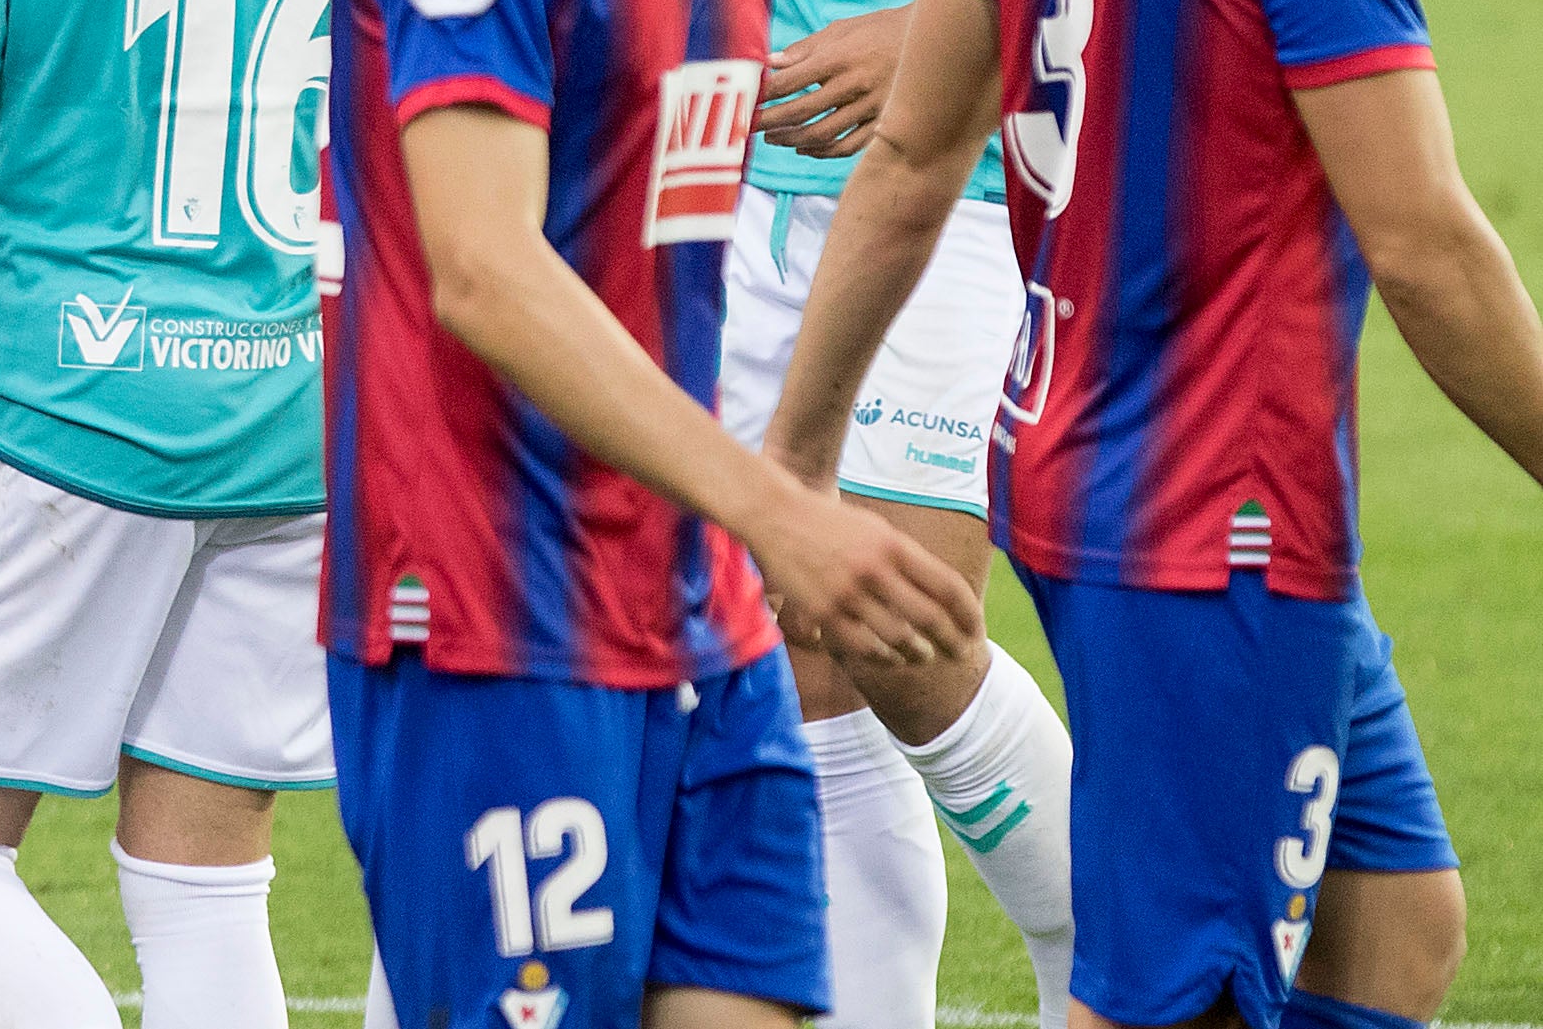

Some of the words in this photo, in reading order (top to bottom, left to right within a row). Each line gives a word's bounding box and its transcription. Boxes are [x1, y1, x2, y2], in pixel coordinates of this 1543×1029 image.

[150, 318, 304, 338] CONSTRUCCIONES
[150, 335, 292, 370] VICTORINO
[890, 408, 984, 442] ACUNSA
[905, 441, 977, 475] hummel
[1273, 745, 1341, 889] 3
[465, 797, 615, 959] 12
